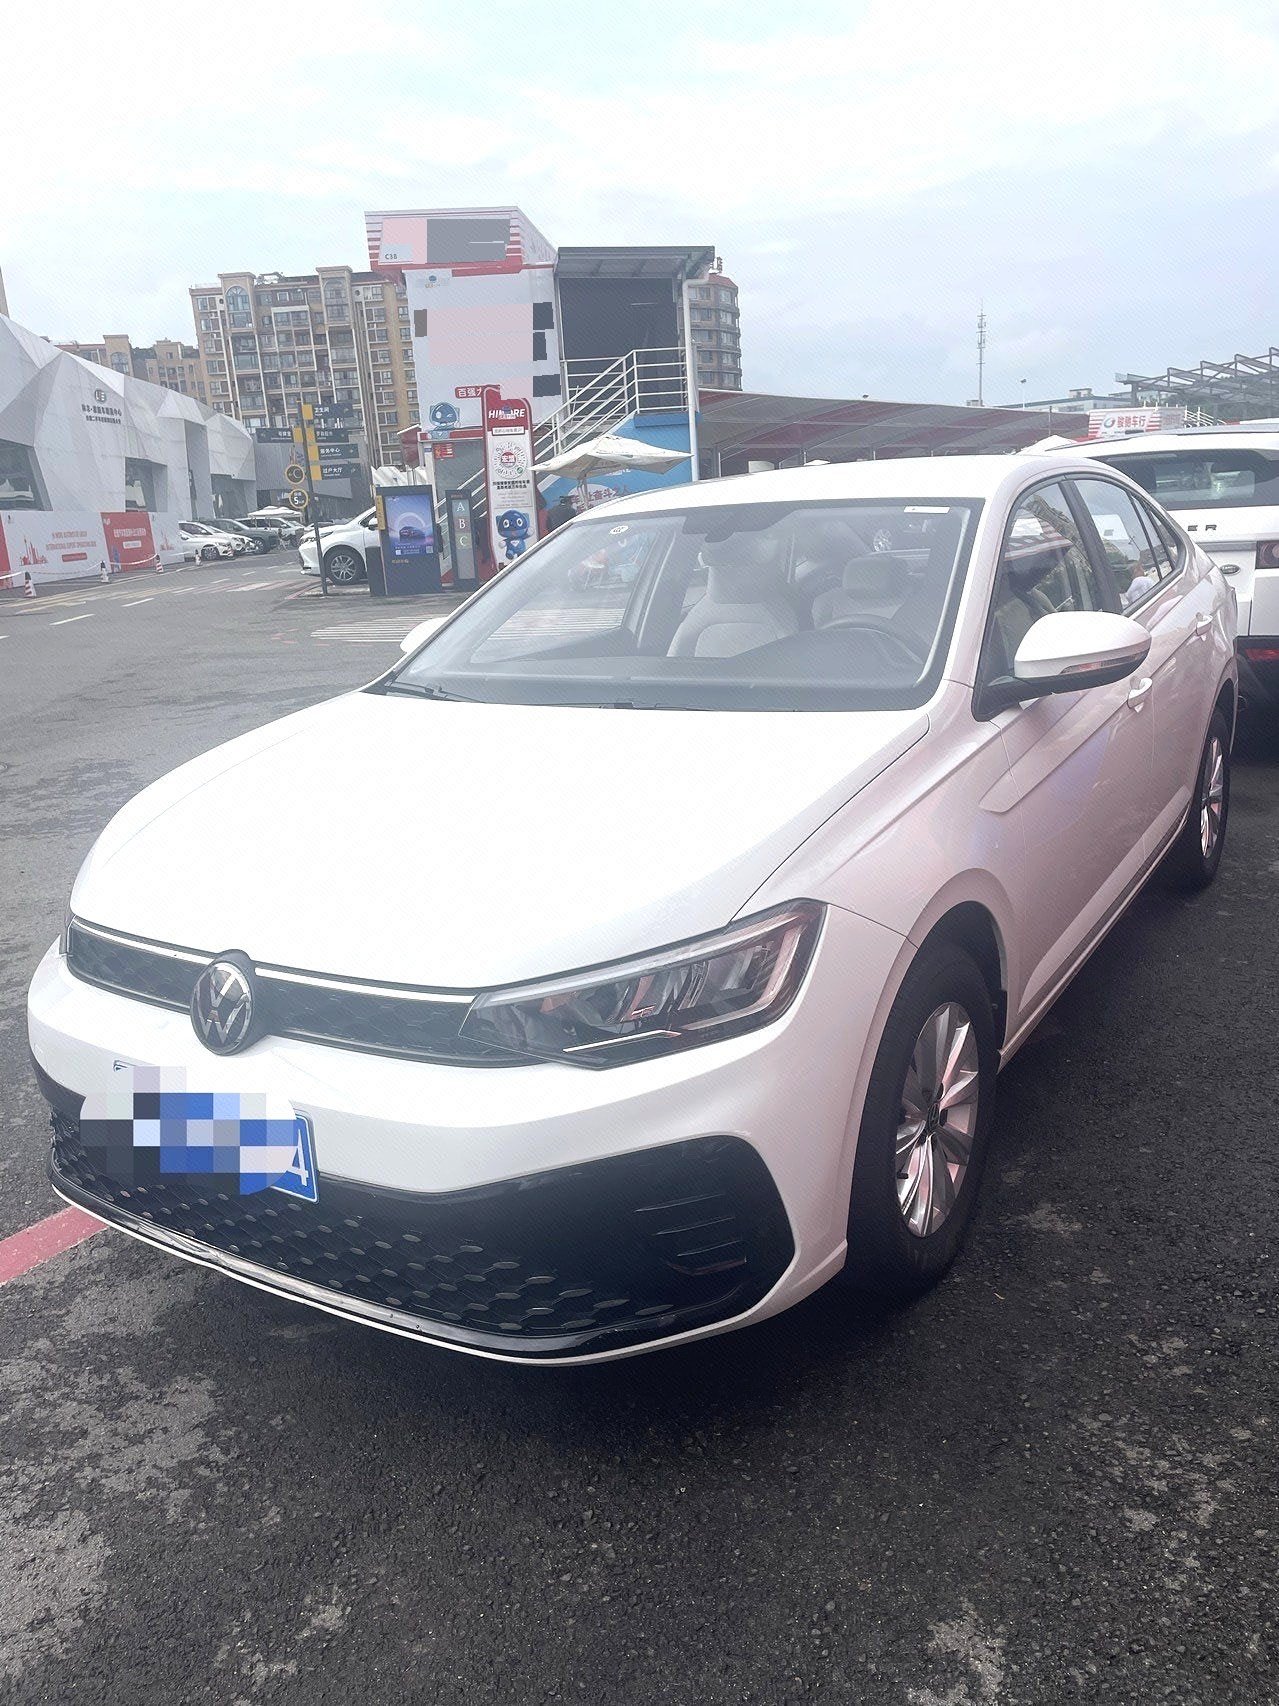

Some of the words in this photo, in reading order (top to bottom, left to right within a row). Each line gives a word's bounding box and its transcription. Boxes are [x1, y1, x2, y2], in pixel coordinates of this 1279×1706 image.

[456, 502, 465, 512] A
[459, 519, 466, 529] B
[460, 536, 468, 547] C
